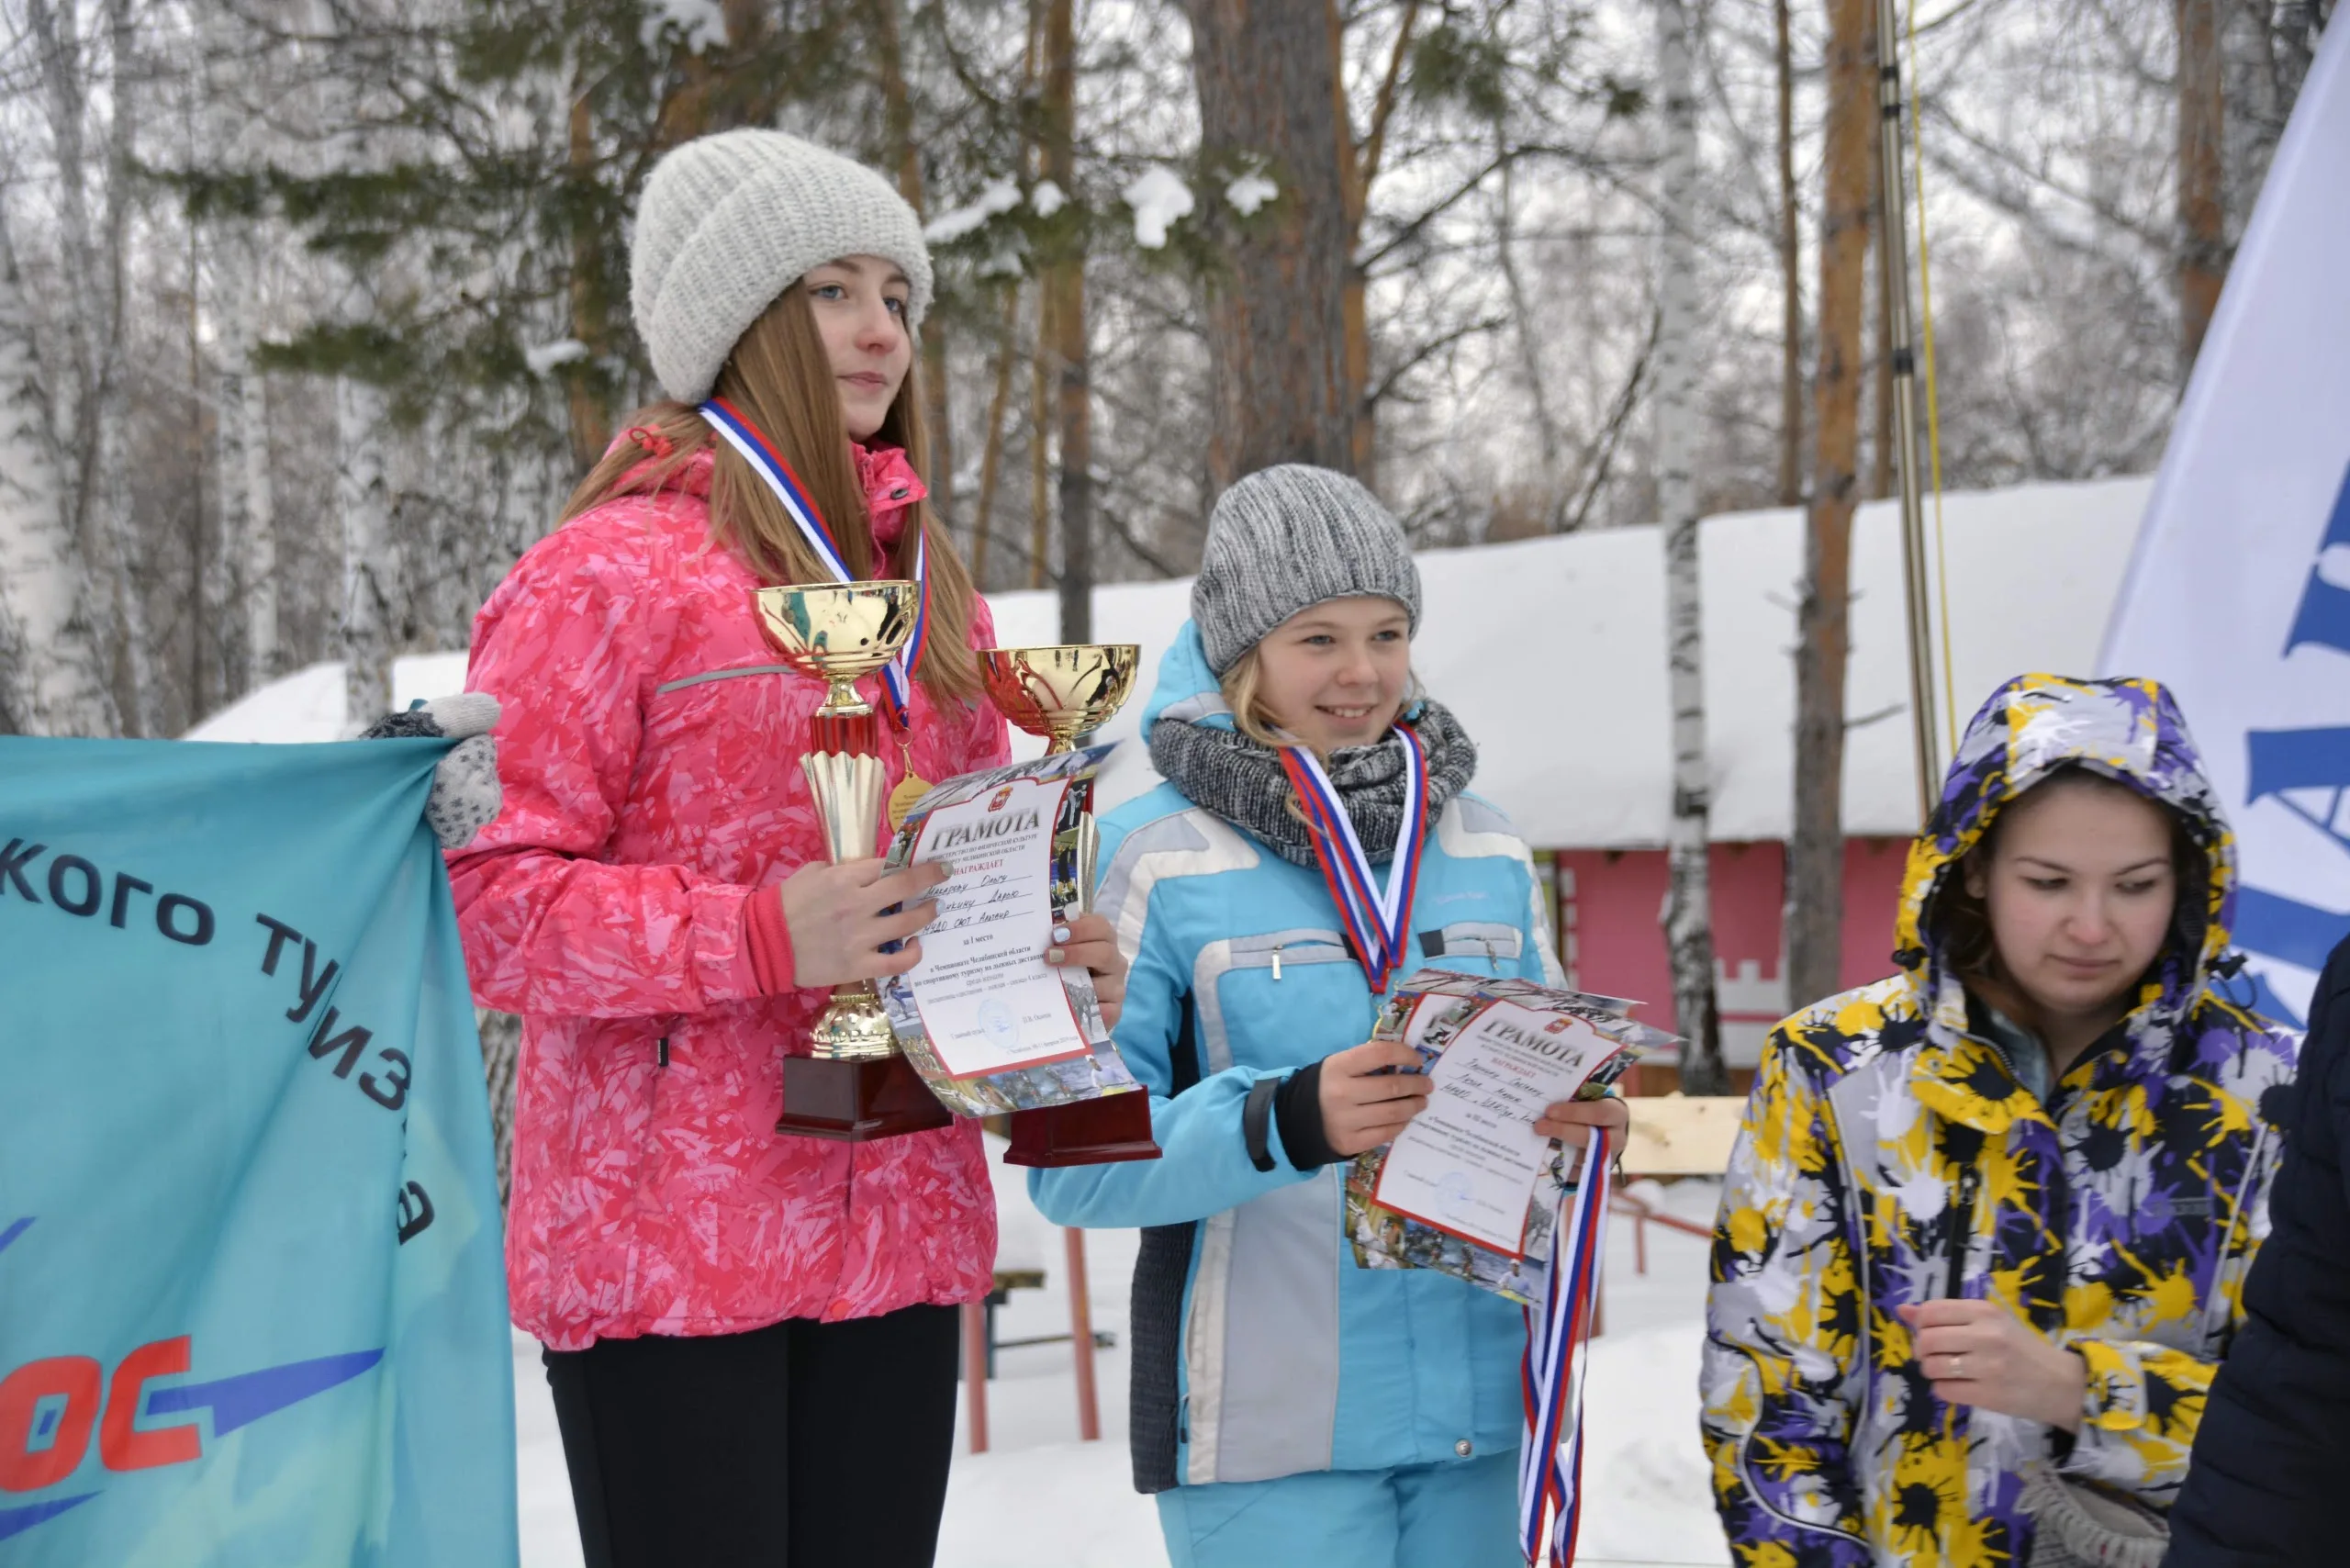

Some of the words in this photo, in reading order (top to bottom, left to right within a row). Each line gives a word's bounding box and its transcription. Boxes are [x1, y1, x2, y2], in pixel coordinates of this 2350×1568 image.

[930, 808, 1040, 852] ГРАМОТА
[954, 859, 1004, 876] НАГРАЖДАЕТ
[975, 934, 994, 944] место
[923, 971, 960, 987] спортивному
[961, 966, 984, 980] туризму
[992, 958, 1017, 970] лыжных
[934, 959, 970, 973] Чемпионате
[969, 950, 1009, 965] Челябинской
[1009, 945, 1032, 957] области
[1483, 1018, 1586, 1068] ГРАМОТА
